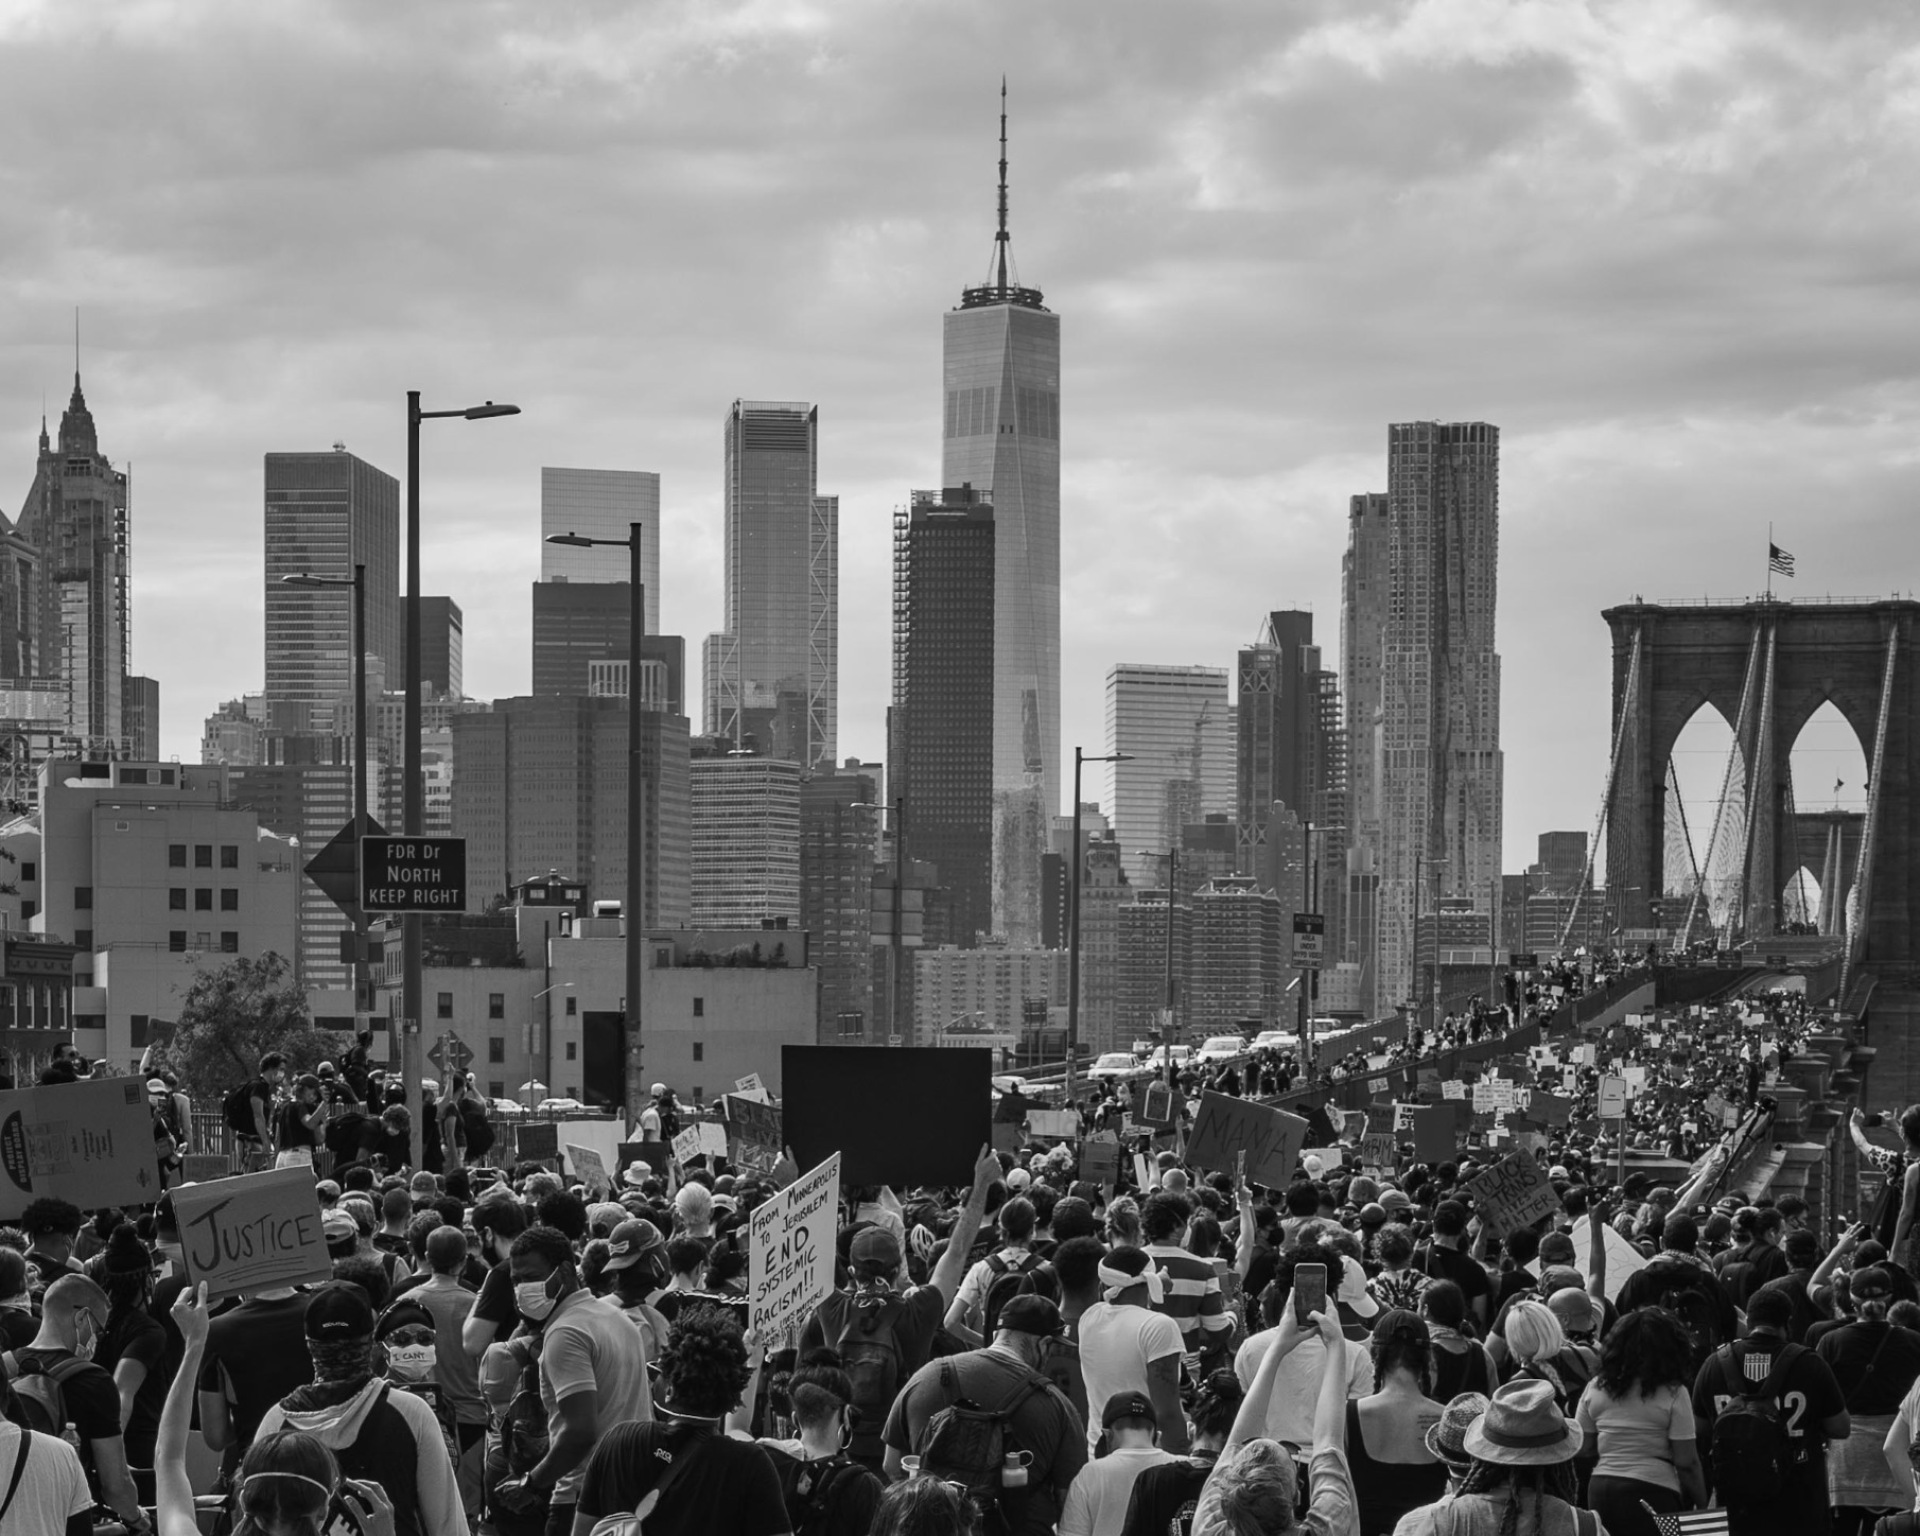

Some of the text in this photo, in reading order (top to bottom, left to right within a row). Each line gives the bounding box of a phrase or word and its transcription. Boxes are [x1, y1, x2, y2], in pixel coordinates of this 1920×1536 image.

[387, 844, 440, 859] FDR Dr
[387, 866, 441, 883] NORTH
[369, 889, 459, 903] KEEP RIGHT
[1195, 1107, 1288, 1175] MAMA
[752, 1164, 837, 1237] FROM MINNEAPOLIS
[1476, 1156, 1522, 1196] BLACK
[186, 1197, 317, 1272] JUSTICE
[760, 1190, 828, 1247] TO JERUSALEM
[756, 1244, 817, 1302] SYSTEMIC
[765, 1225, 809, 1275] END
